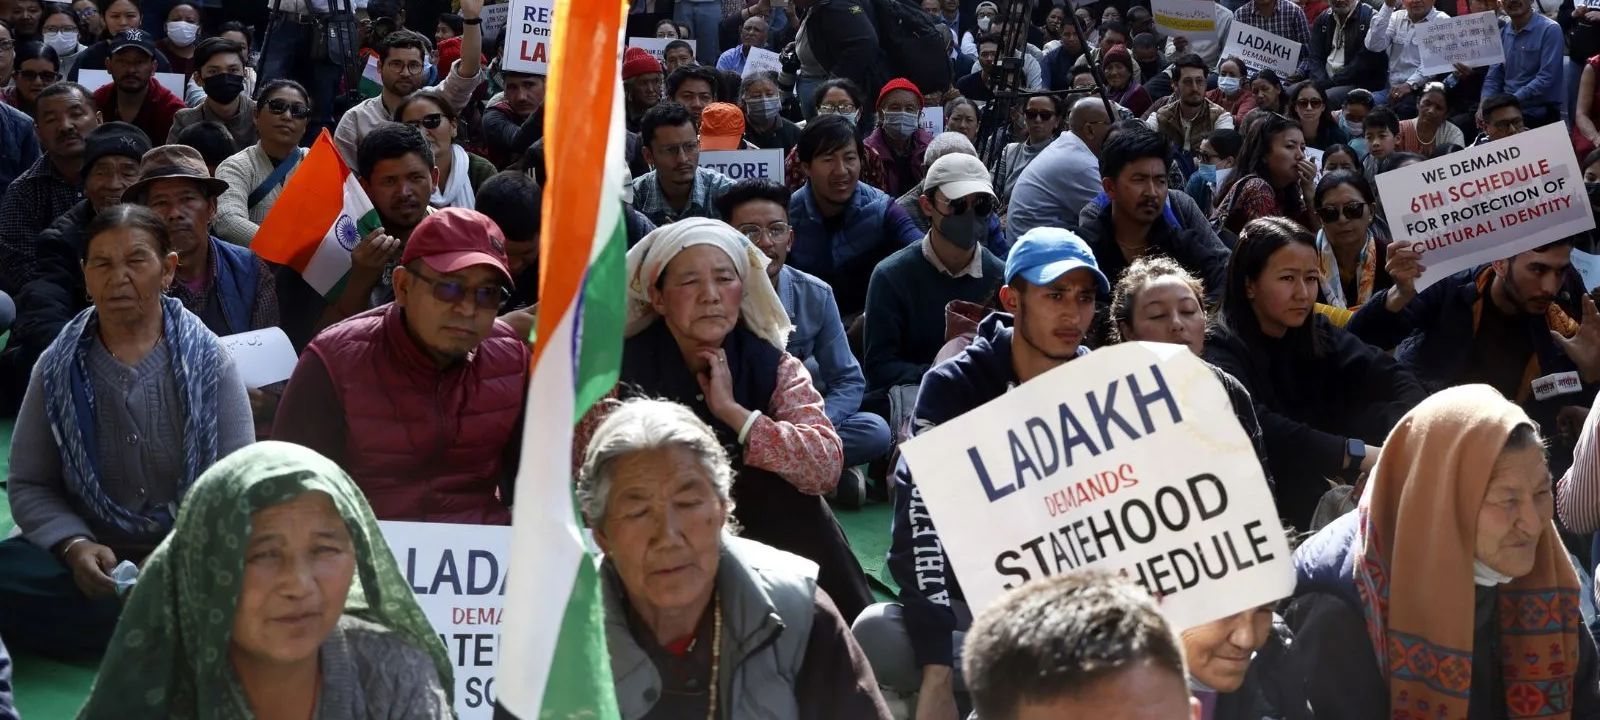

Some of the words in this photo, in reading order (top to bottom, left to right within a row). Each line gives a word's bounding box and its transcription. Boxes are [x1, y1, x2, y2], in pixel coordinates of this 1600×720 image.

[1237, 31, 1292, 60] LADAKH
[698, 162, 768, 179] TORE
[1410, 191, 1444, 213] 6TH
[1448, 159, 1550, 202] SCHEDULE
[1422, 168, 1447, 184] WE
[1450, 146, 1521, 177] DEMAND
[1406, 217, 1438, 236] FOR
[1442, 186, 1539, 227] PROTECTION
[1544, 178, 1566, 193] OF
[1412, 221, 1496, 255] CULTURAL
[1500, 195, 1571, 228] IDENTITY
[966, 364, 1183, 502] LADAKH
[1044, 464, 1139, 517] DEMANDS
[994, 472, 1228, 591] STATEHOOD
[439, 634, 500, 666] TE
